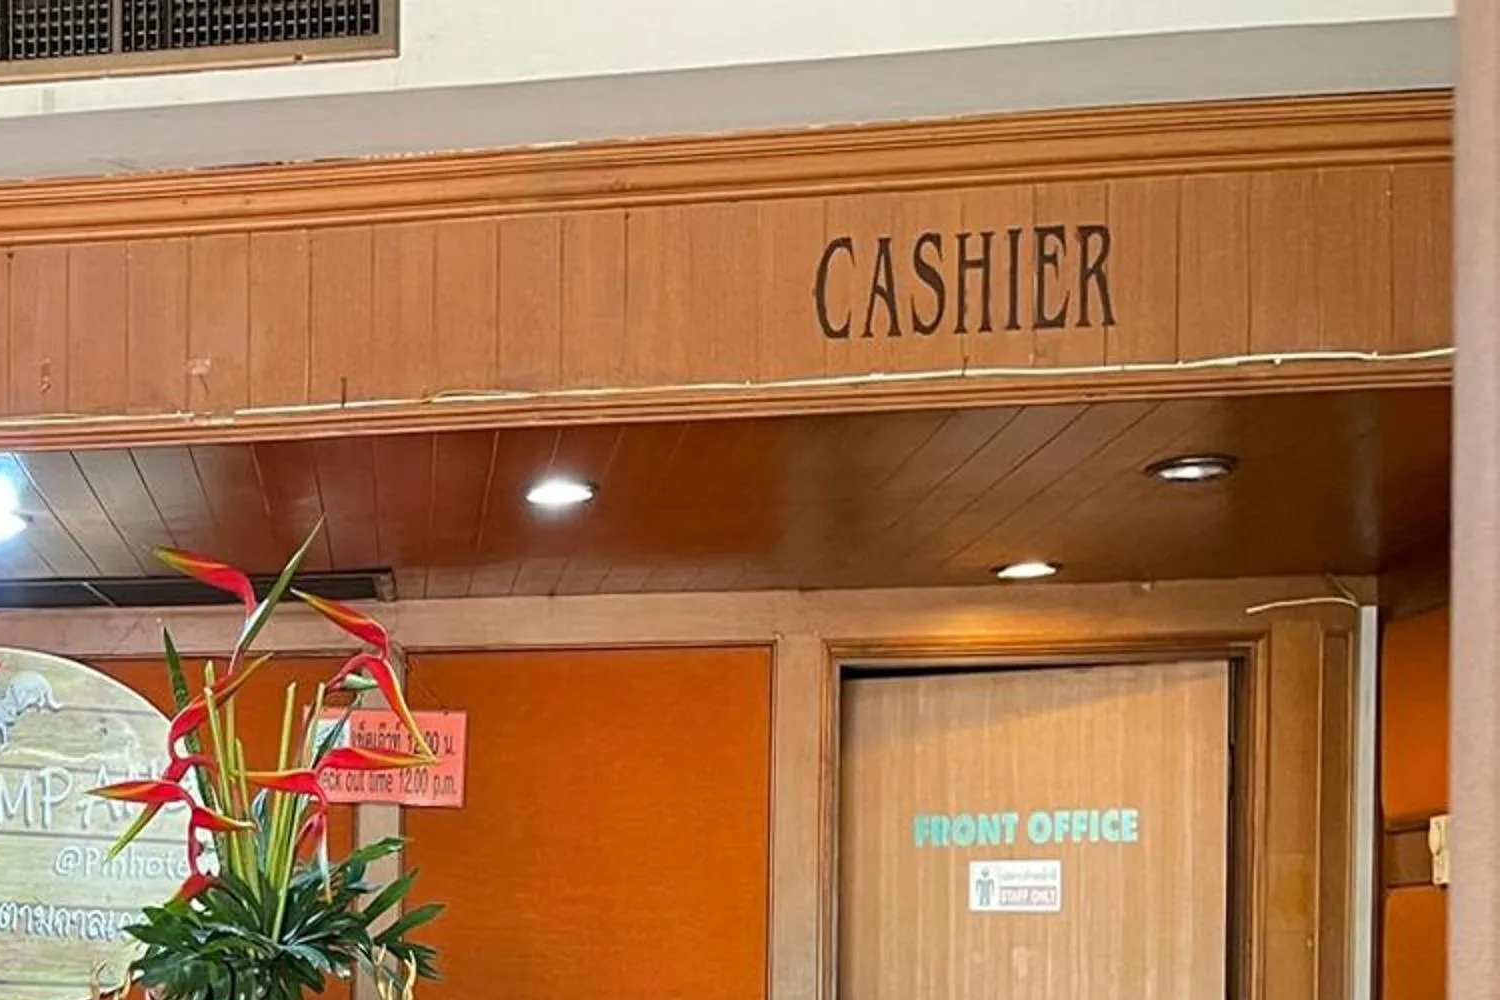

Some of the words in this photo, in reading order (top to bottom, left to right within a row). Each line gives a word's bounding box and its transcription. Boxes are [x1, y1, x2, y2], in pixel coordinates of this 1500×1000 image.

[813, 224, 1117, 339] CASHIER
[346, 771, 365, 793] out
[368, 771, 394, 793] time
[914, 812, 1019, 848] FRONT
[1027, 808, 1139, 845] OFFICE
